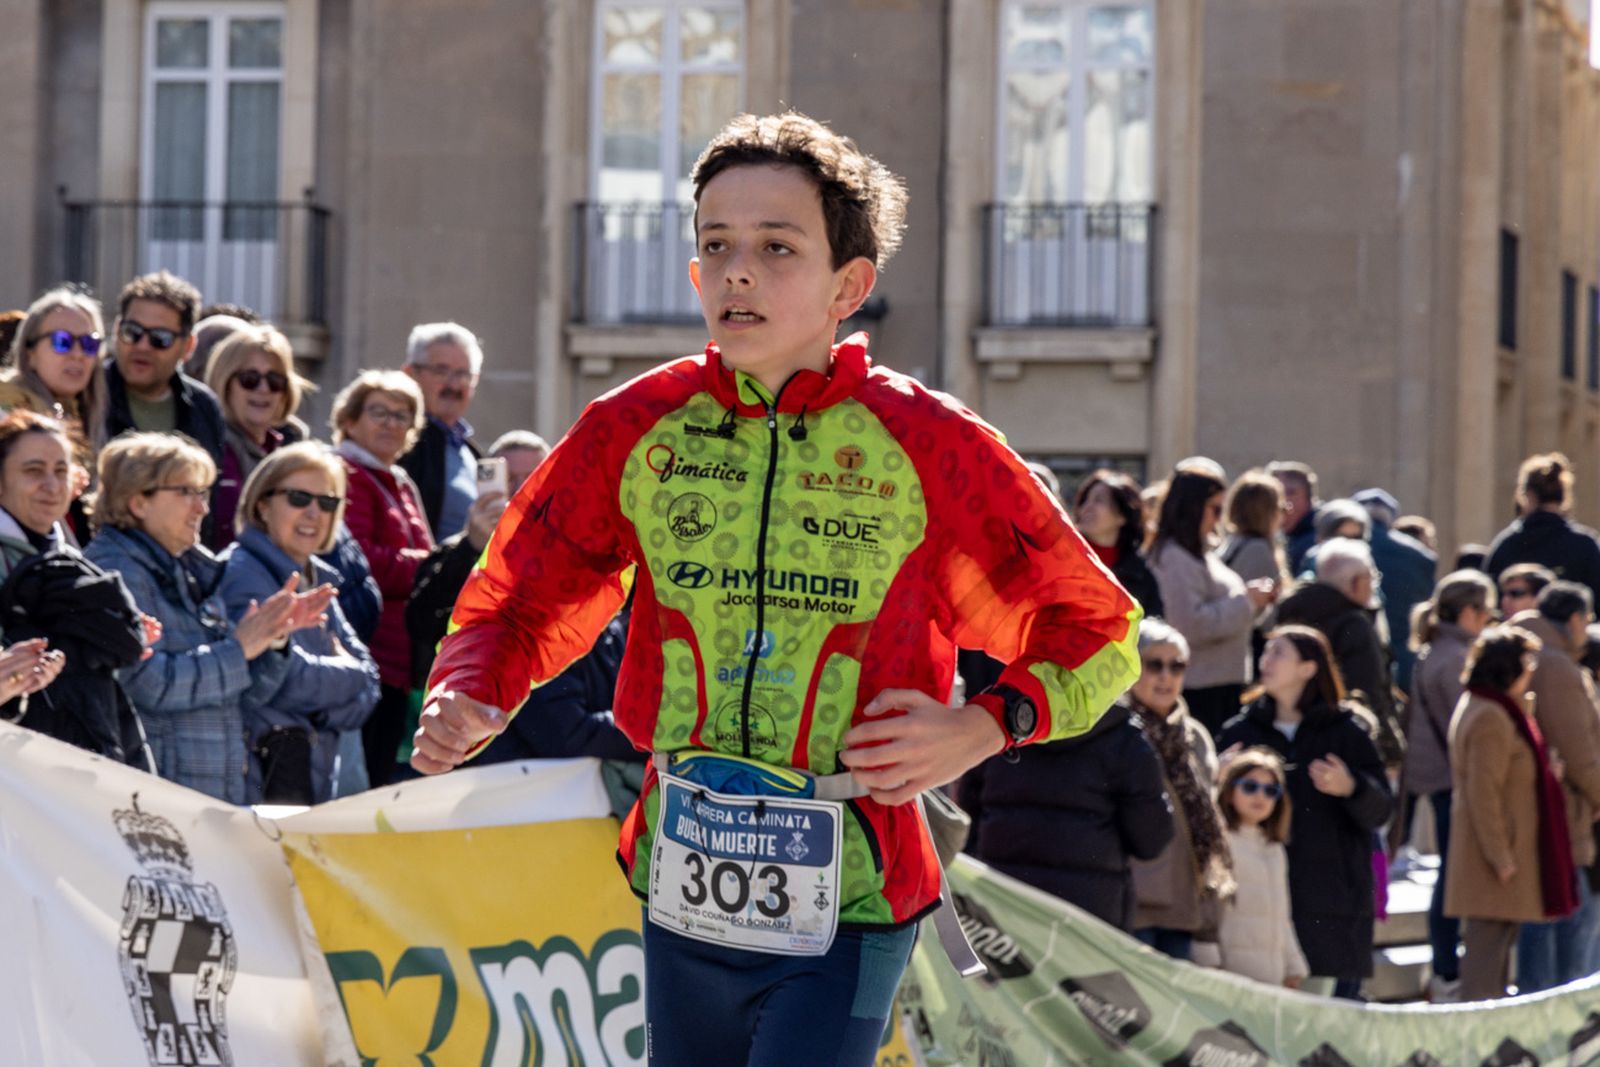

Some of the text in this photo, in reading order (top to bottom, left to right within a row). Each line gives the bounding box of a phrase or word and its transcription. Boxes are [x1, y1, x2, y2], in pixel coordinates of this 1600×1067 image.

[823, 518, 880, 544] DUE
[721, 568, 859, 600] HYUNDAI
[721, 591, 857, 615] Jacarsa Motor
[738, 811, 812, 830] CAMINATA
[711, 829, 778, 857] MUERTE
[681, 852, 791, 918] 303
